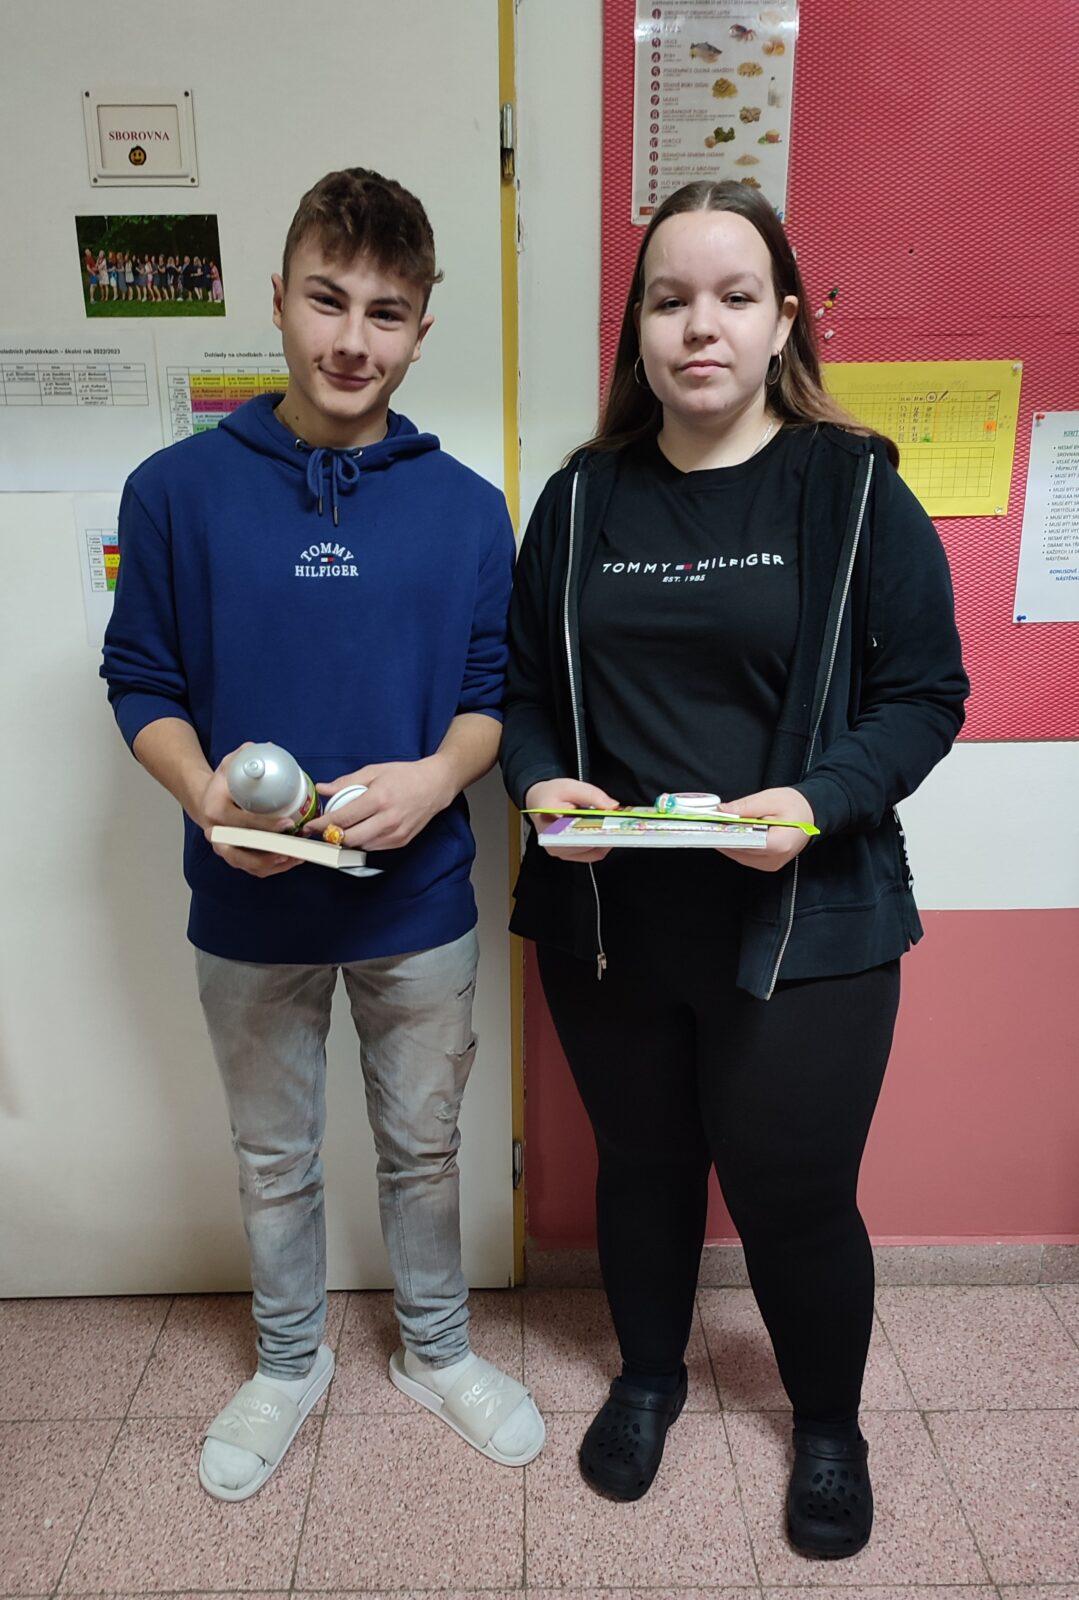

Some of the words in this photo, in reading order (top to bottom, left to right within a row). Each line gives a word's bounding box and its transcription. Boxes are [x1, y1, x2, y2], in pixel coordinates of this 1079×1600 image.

[108, 131, 170, 141] SBOROVNA
[300, 542, 354, 562] TOMMY
[602, 561, 672, 574] TOMMY
[697, 552, 785, 571] HILFIGER
[294, 564, 359, 578] HILFIGER
[685, 574, 706, 582] 1985
